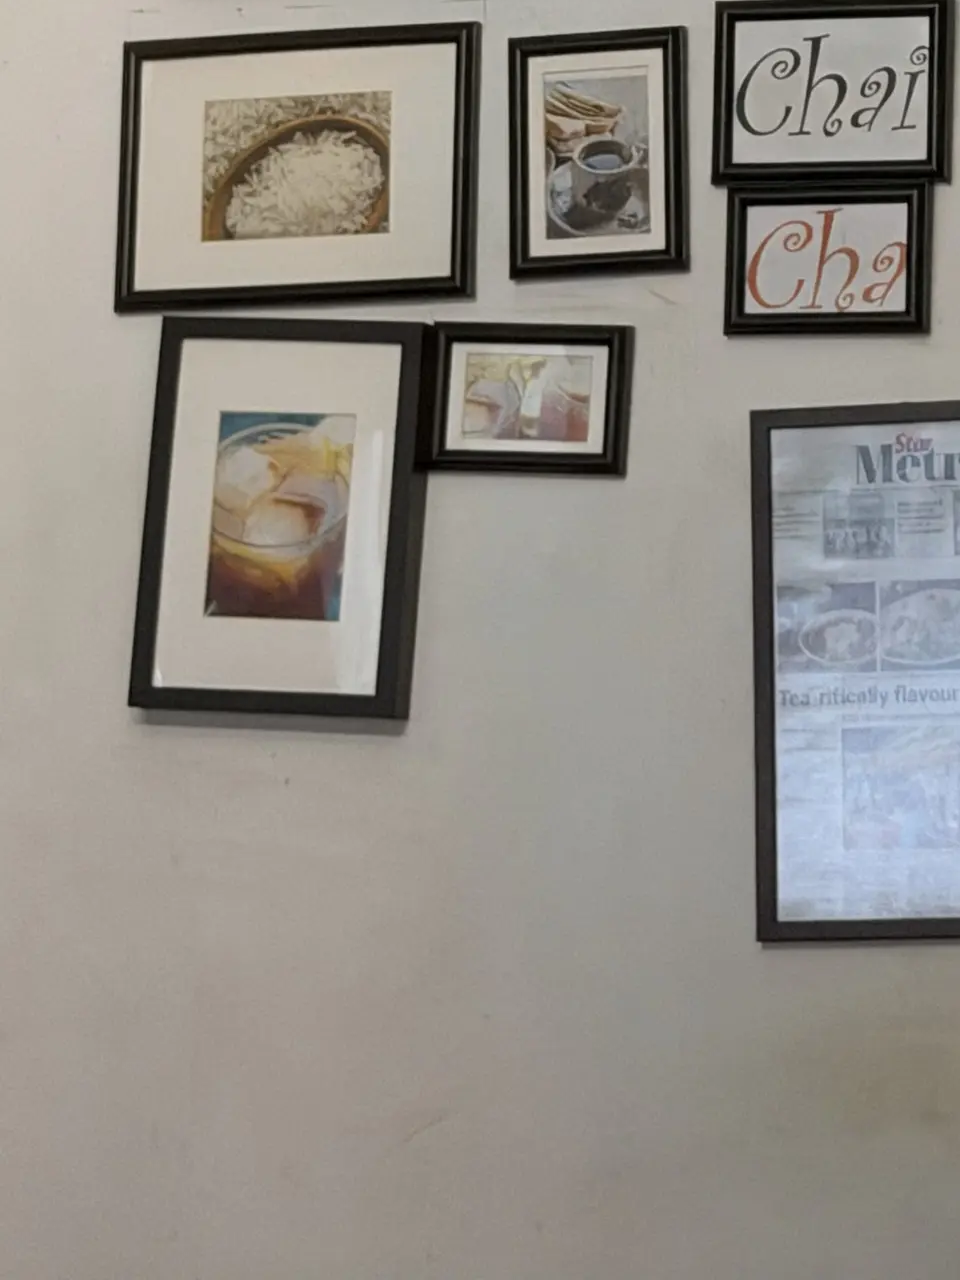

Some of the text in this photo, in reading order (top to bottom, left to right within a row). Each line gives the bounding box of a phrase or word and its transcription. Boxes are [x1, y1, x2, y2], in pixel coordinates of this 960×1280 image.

[735, 33, 930, 138] Chai
[747, 207, 908, 312] Cha
[779, 689, 811, 708] Tea
